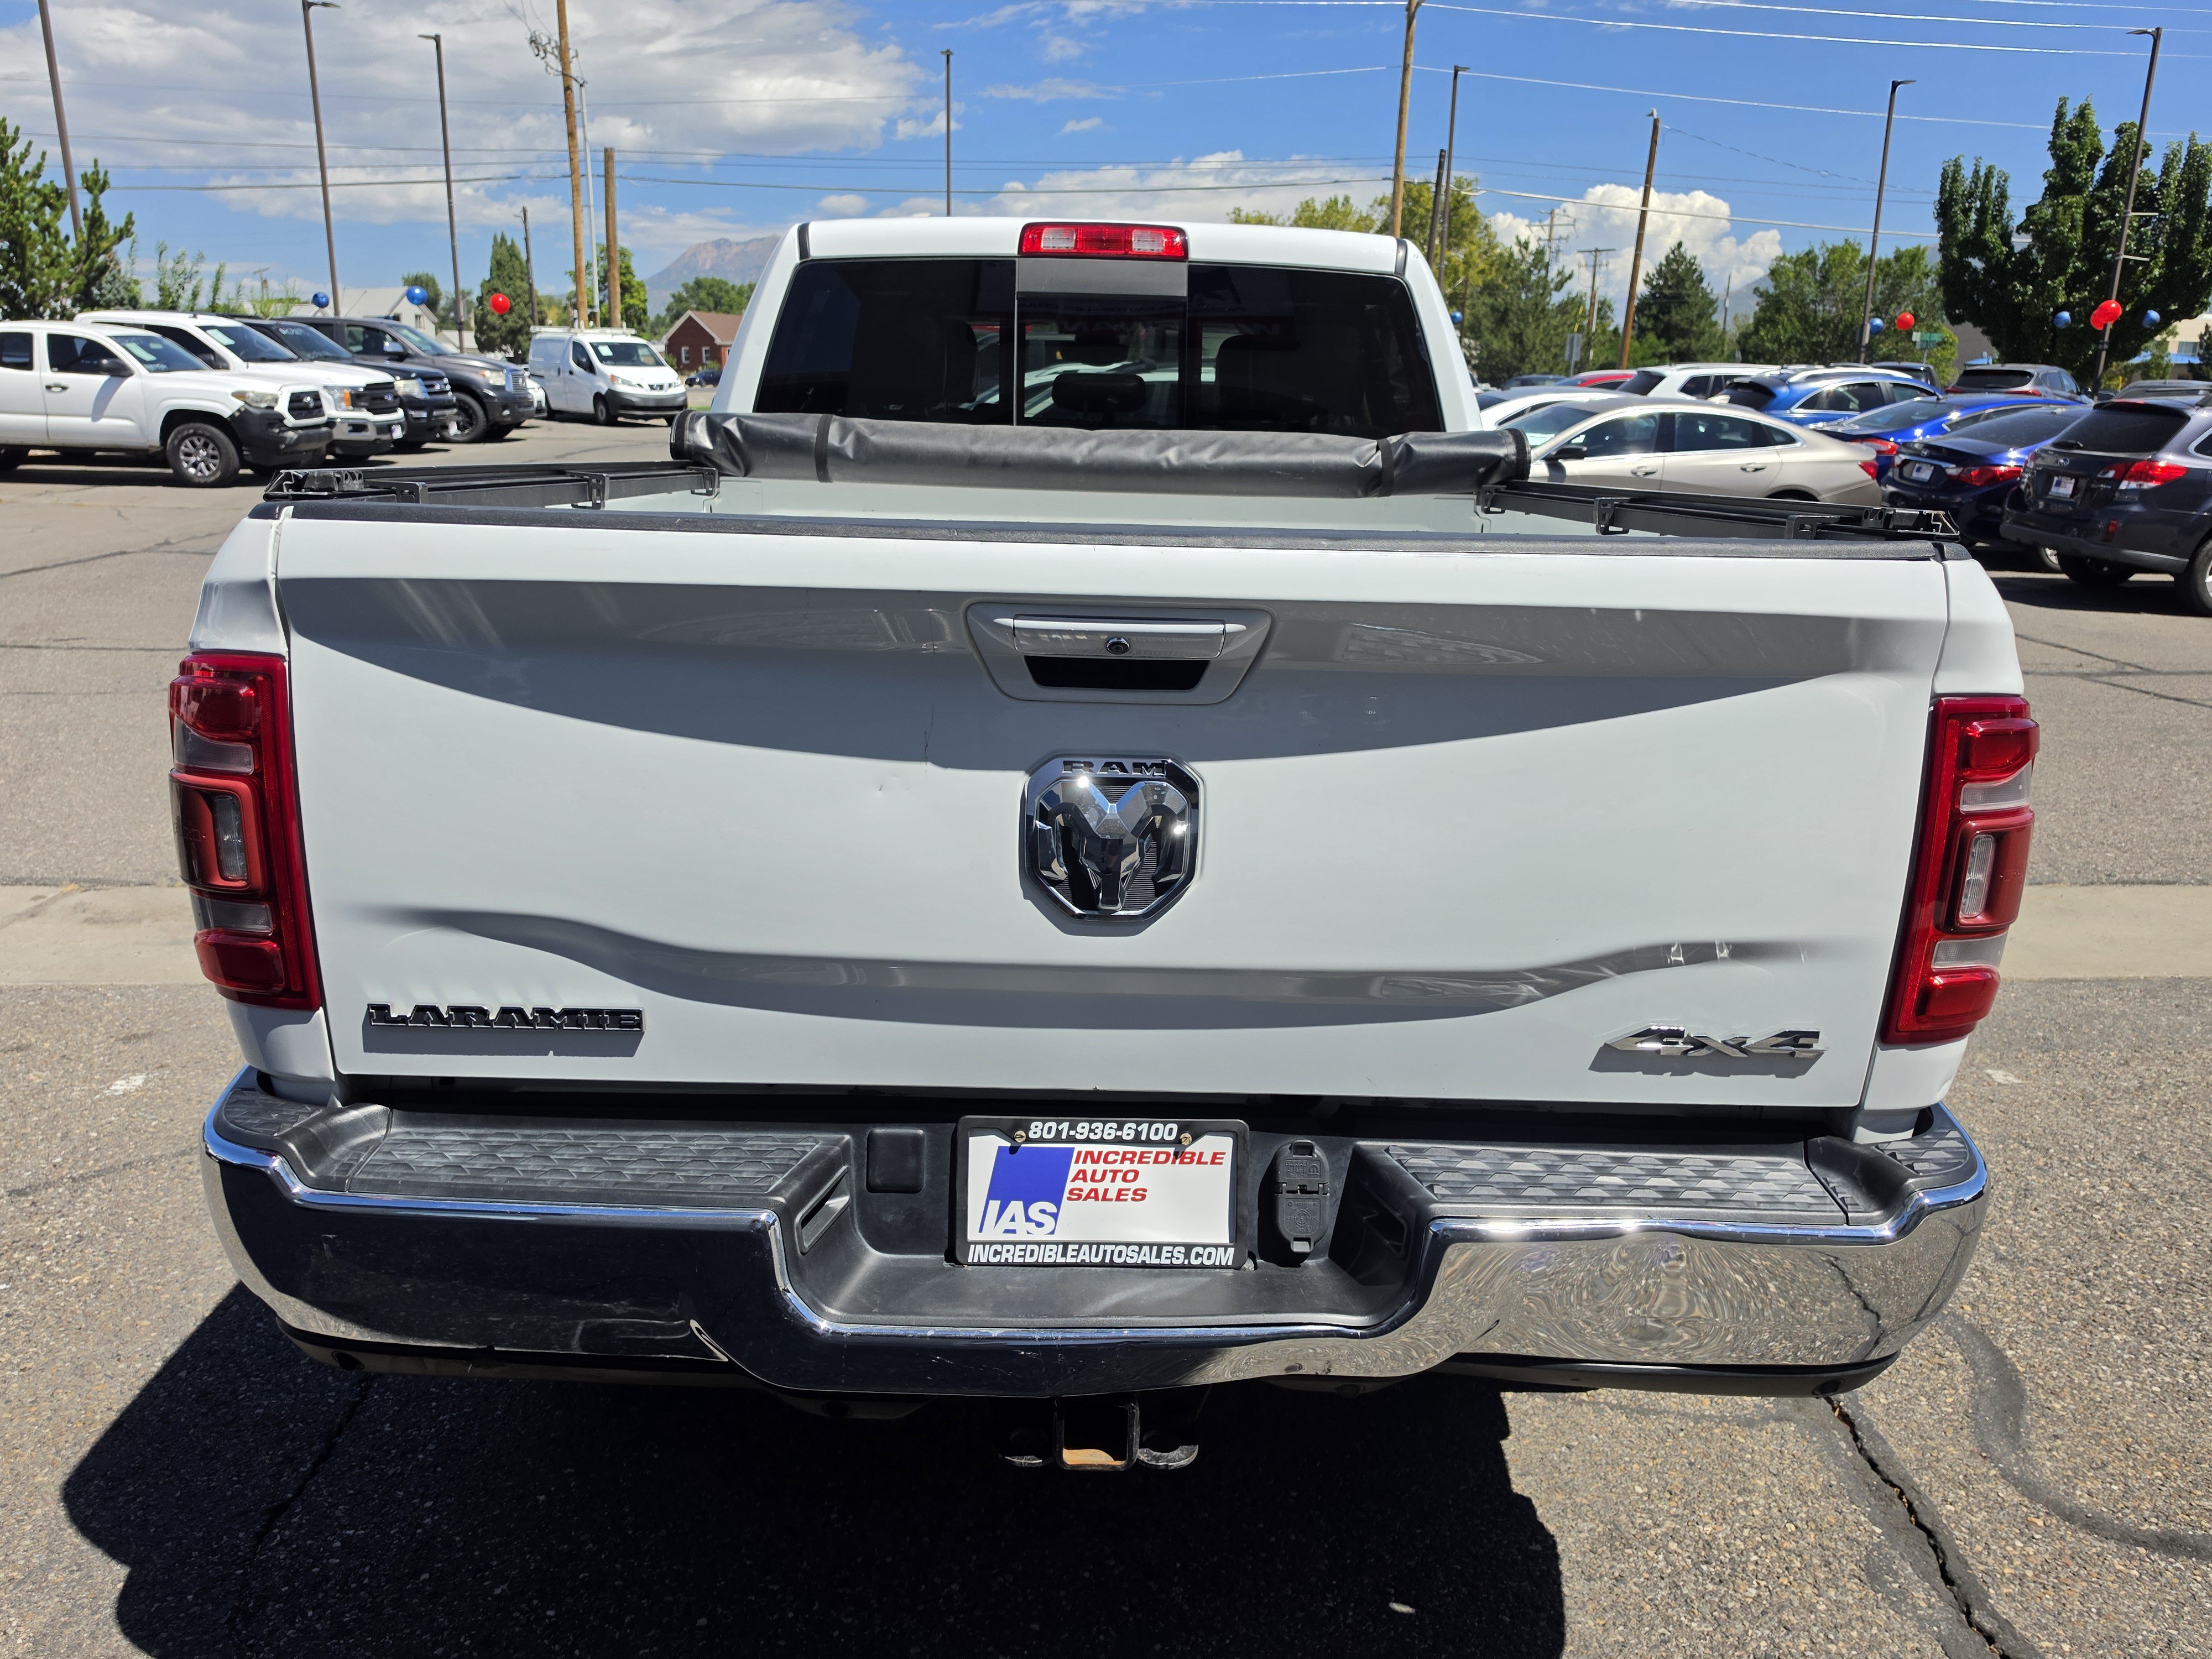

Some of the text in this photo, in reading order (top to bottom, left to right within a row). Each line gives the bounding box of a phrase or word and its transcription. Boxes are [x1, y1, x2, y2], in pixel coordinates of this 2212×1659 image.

[1062, 760, 1167, 777] RAM
[367, 1003, 645, 1031] LARAMIE
[1028, 1121, 1178, 1141] 801-936-6100
[1074, 1150, 1227, 1166] INCREDIBLE
[1070, 1169, 1140, 1183] AUTO
[1066, 1187, 1148, 1202] SALES
[982, 1199, 1057, 1235] IAS
[968, 1244, 1235, 1266] INCREDIBLEAUTOSALES.COM
